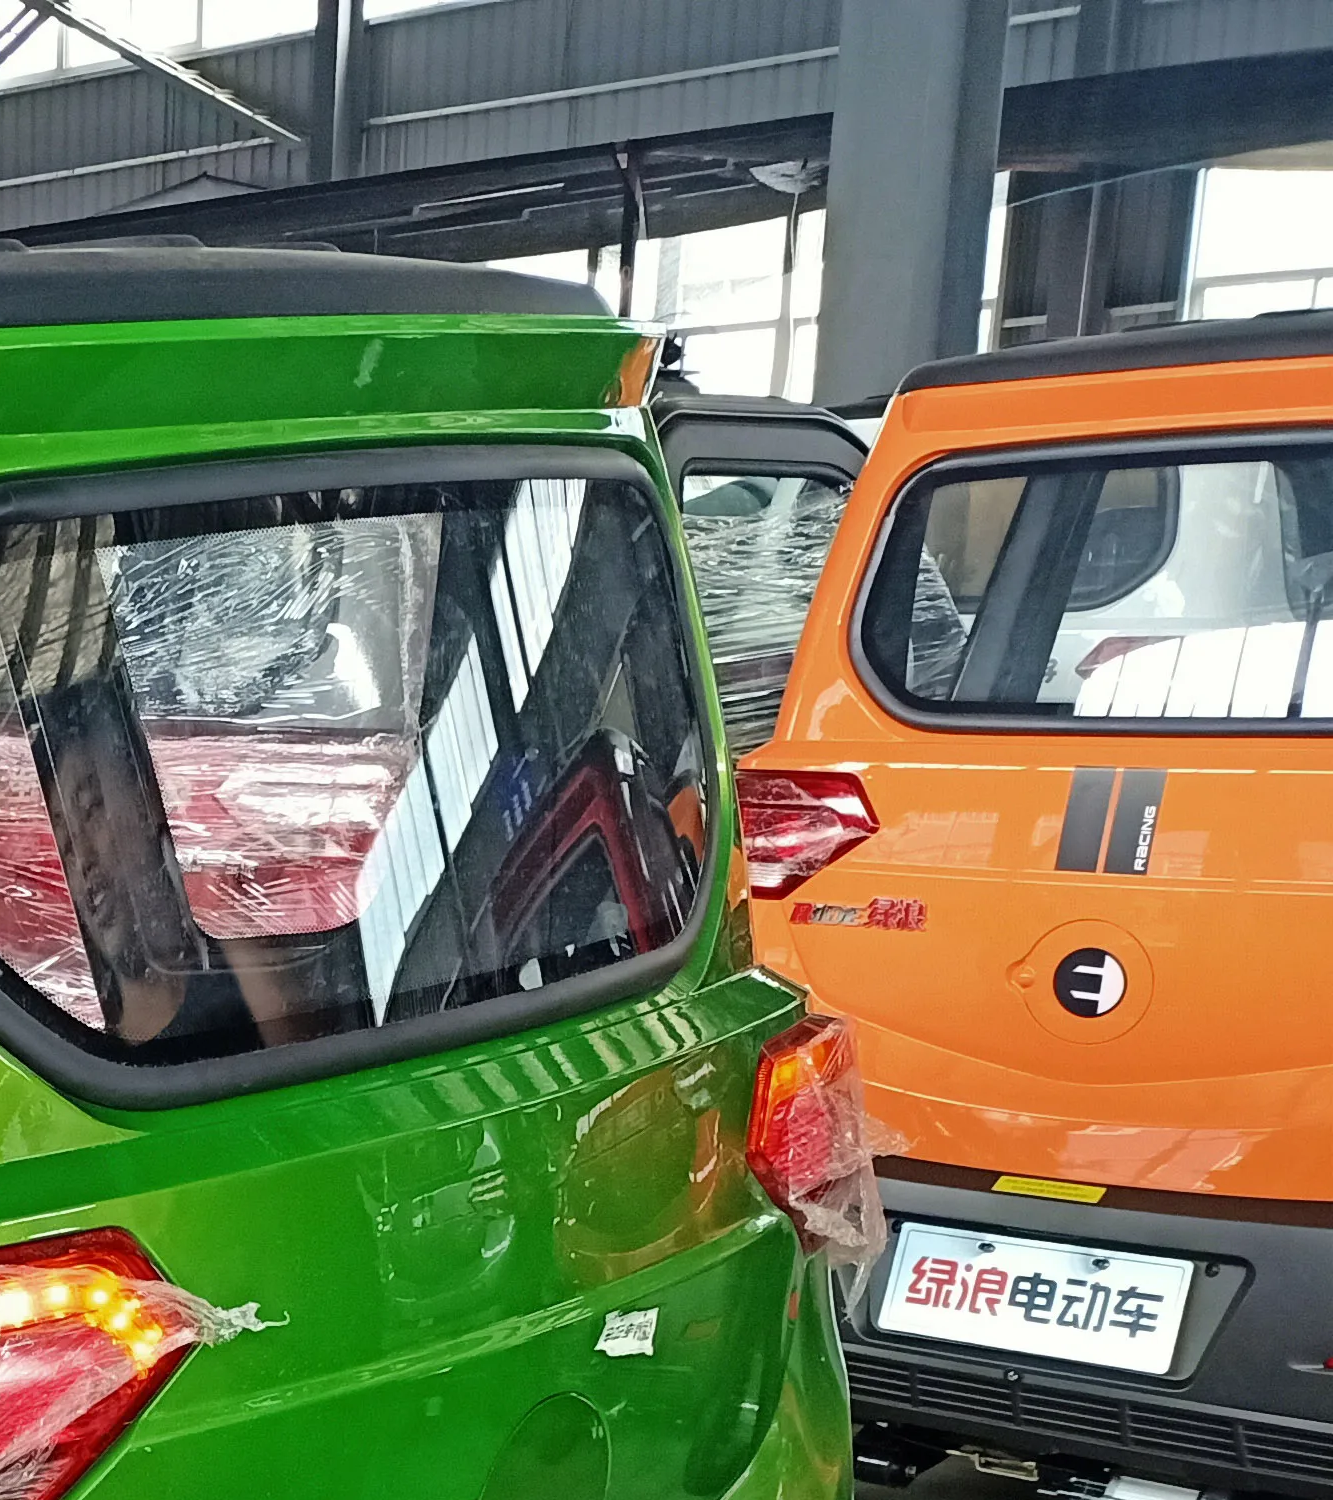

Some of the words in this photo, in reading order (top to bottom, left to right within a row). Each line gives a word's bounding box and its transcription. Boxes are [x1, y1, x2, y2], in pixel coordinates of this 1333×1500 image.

[1133, 805, 1157, 871] RACING
[905, 1256, 1165, 1338] 绿浪电动车
